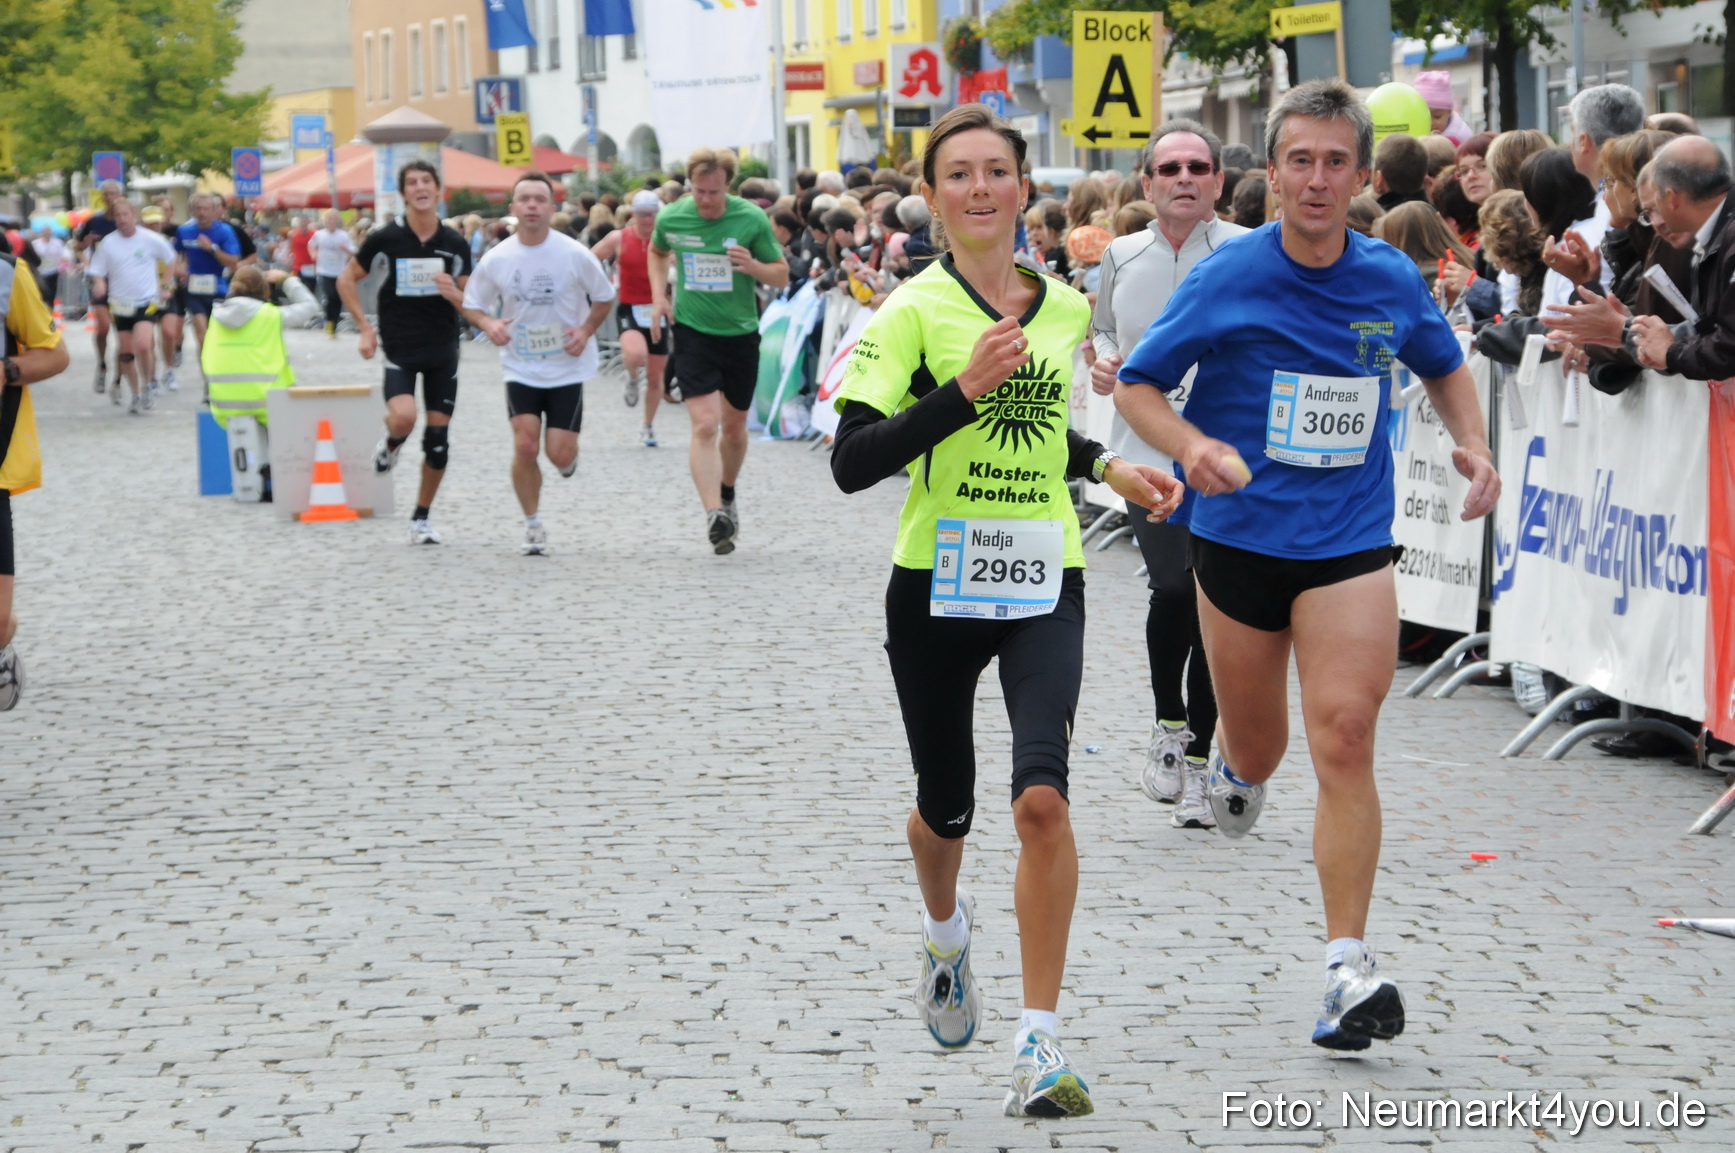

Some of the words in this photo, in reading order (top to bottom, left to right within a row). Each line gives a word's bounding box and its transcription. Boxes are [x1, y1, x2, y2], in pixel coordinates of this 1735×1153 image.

[1084, 18, 1152, 42] Block
[1287, 12, 1331, 27] Toiletten
[1092, 54, 1142, 118] A
[506, 129, 525, 154] B
[411, 272, 434, 282] 307
[697, 267, 727, 278] 2258
[530, 337, 556, 349] 3151
[856, 338, 879, 349] ter-
[1304, 384, 1359, 403] Andreas
[993, 400, 1047, 420] Team
[1276, 405, 1285, 418] B
[1302, 411, 1366, 436] 3066
[968, 461, 1047, 482] Kloster-
[1408, 450, 1427, 481] Im
[956, 481, 1050, 504] Apotheke
[1404, 489, 1430, 520] der
[971, 528, 1013, 551] Nadja
[942, 555, 950, 568] B
[969, 558, 1046, 585] 2963
[1400, 546, 1438, 580] 92318
[1009, 603, 1054, 614] PFLEIDERER
